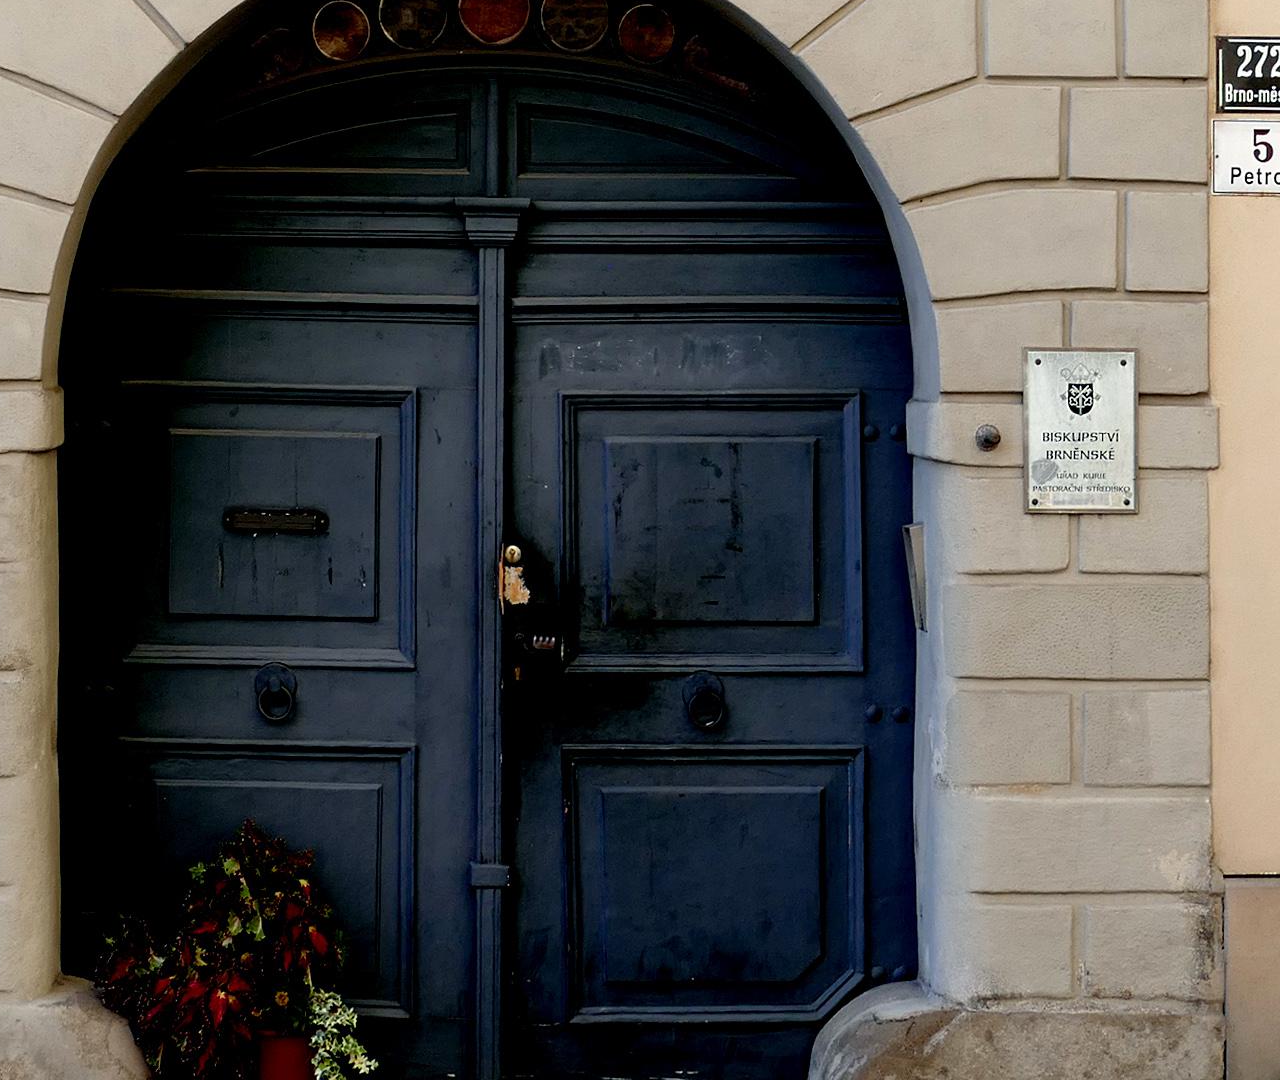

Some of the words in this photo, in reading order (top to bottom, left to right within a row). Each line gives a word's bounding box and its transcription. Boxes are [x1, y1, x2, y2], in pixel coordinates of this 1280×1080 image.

[1253, 129, 1274, 163] 5
[1042, 429, 1120, 442] BISKUPSTVÍ
[1046, 447, 1115, 460] BRNĚNSKÉ
